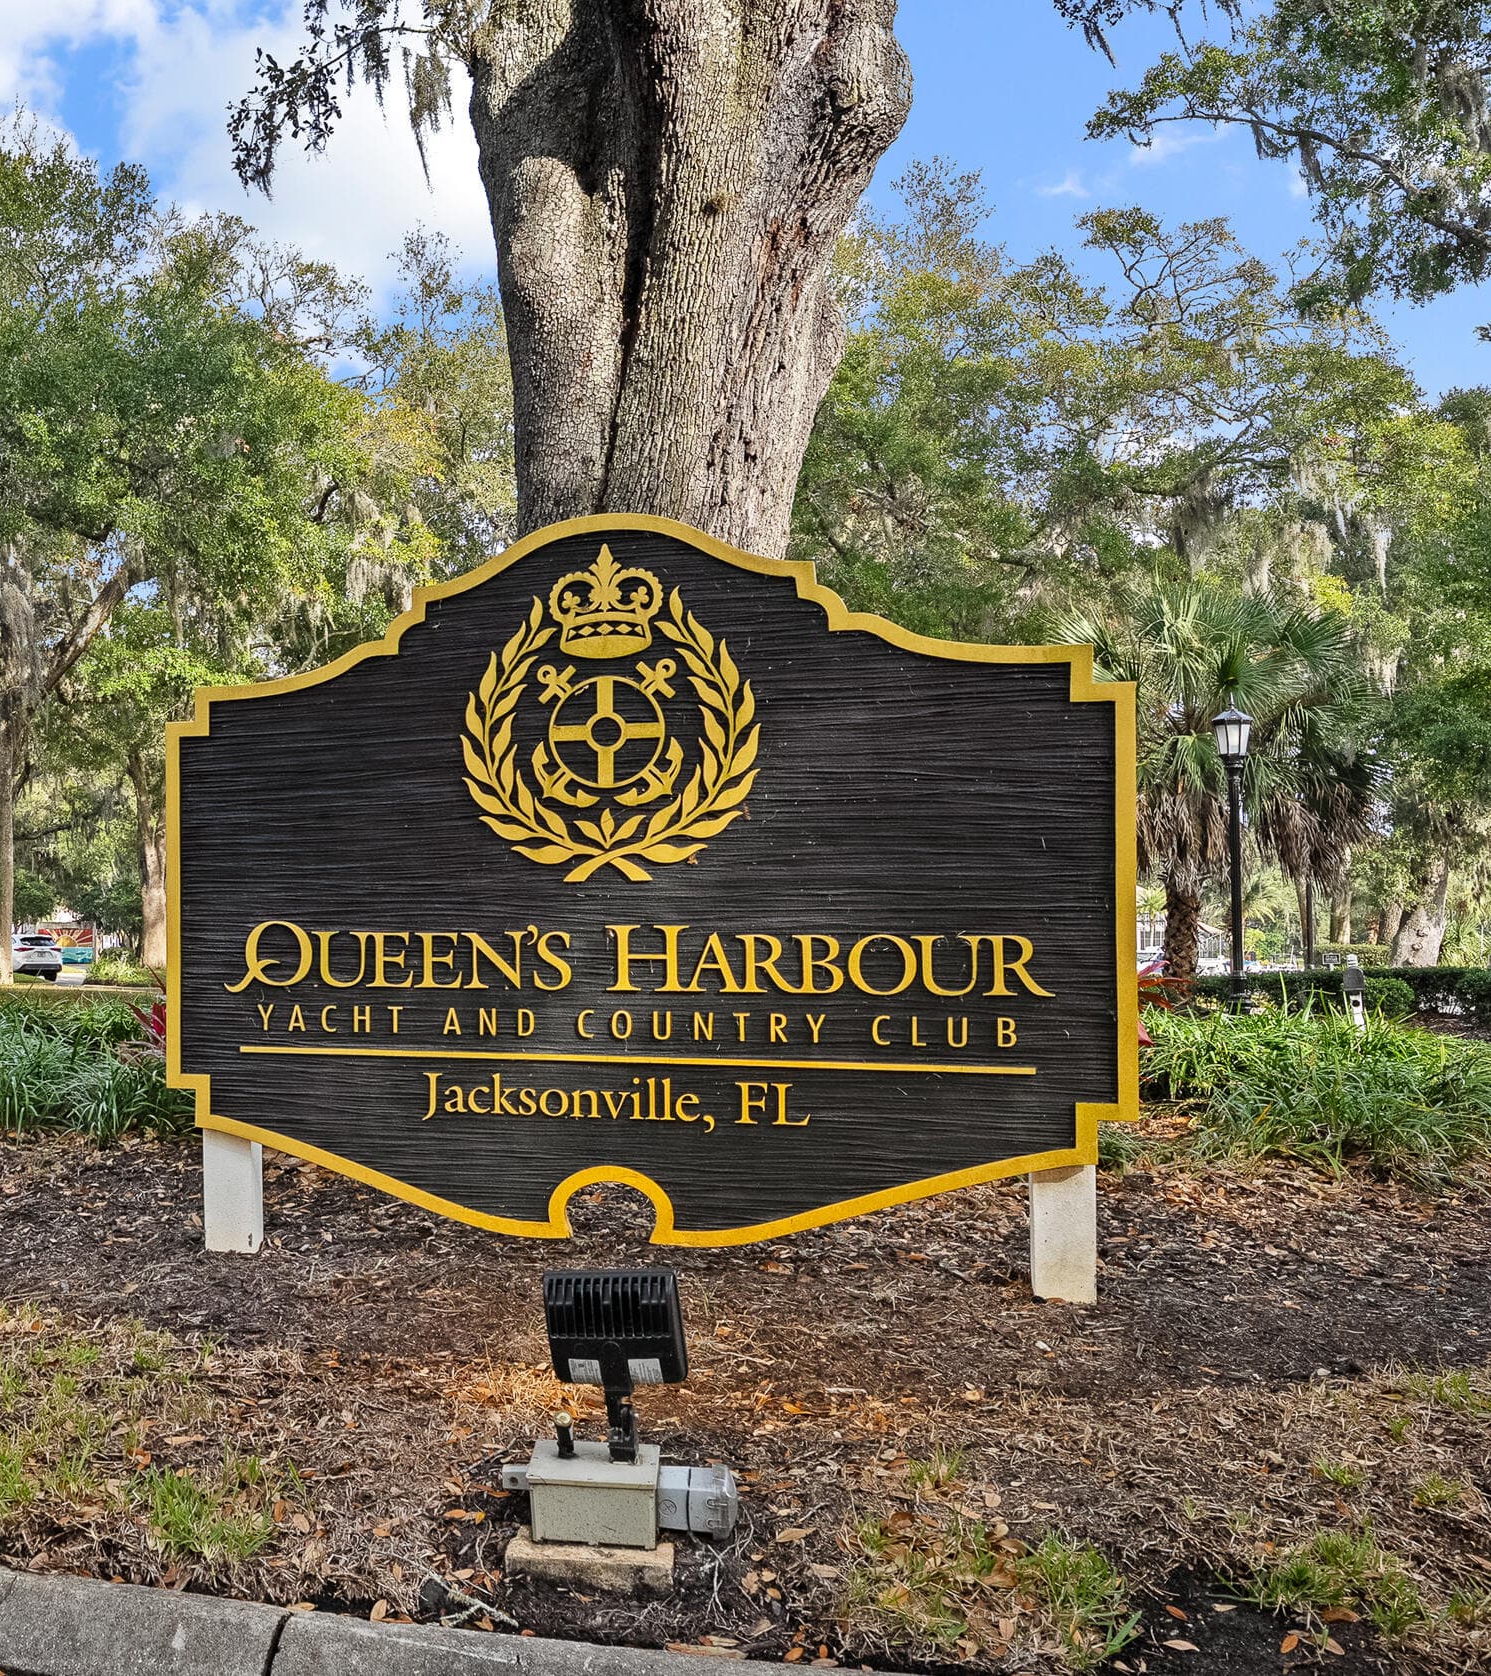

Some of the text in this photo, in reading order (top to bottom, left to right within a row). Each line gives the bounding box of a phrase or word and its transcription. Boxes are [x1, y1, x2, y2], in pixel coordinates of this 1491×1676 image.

[224, 920, 1055, 998] QUEEN'S HARBOUR
[257, 1004, 1019, 1048] YACHT AND COUNTRY CLUB
[422, 1071, 811, 1133] Jacksonville, FL
